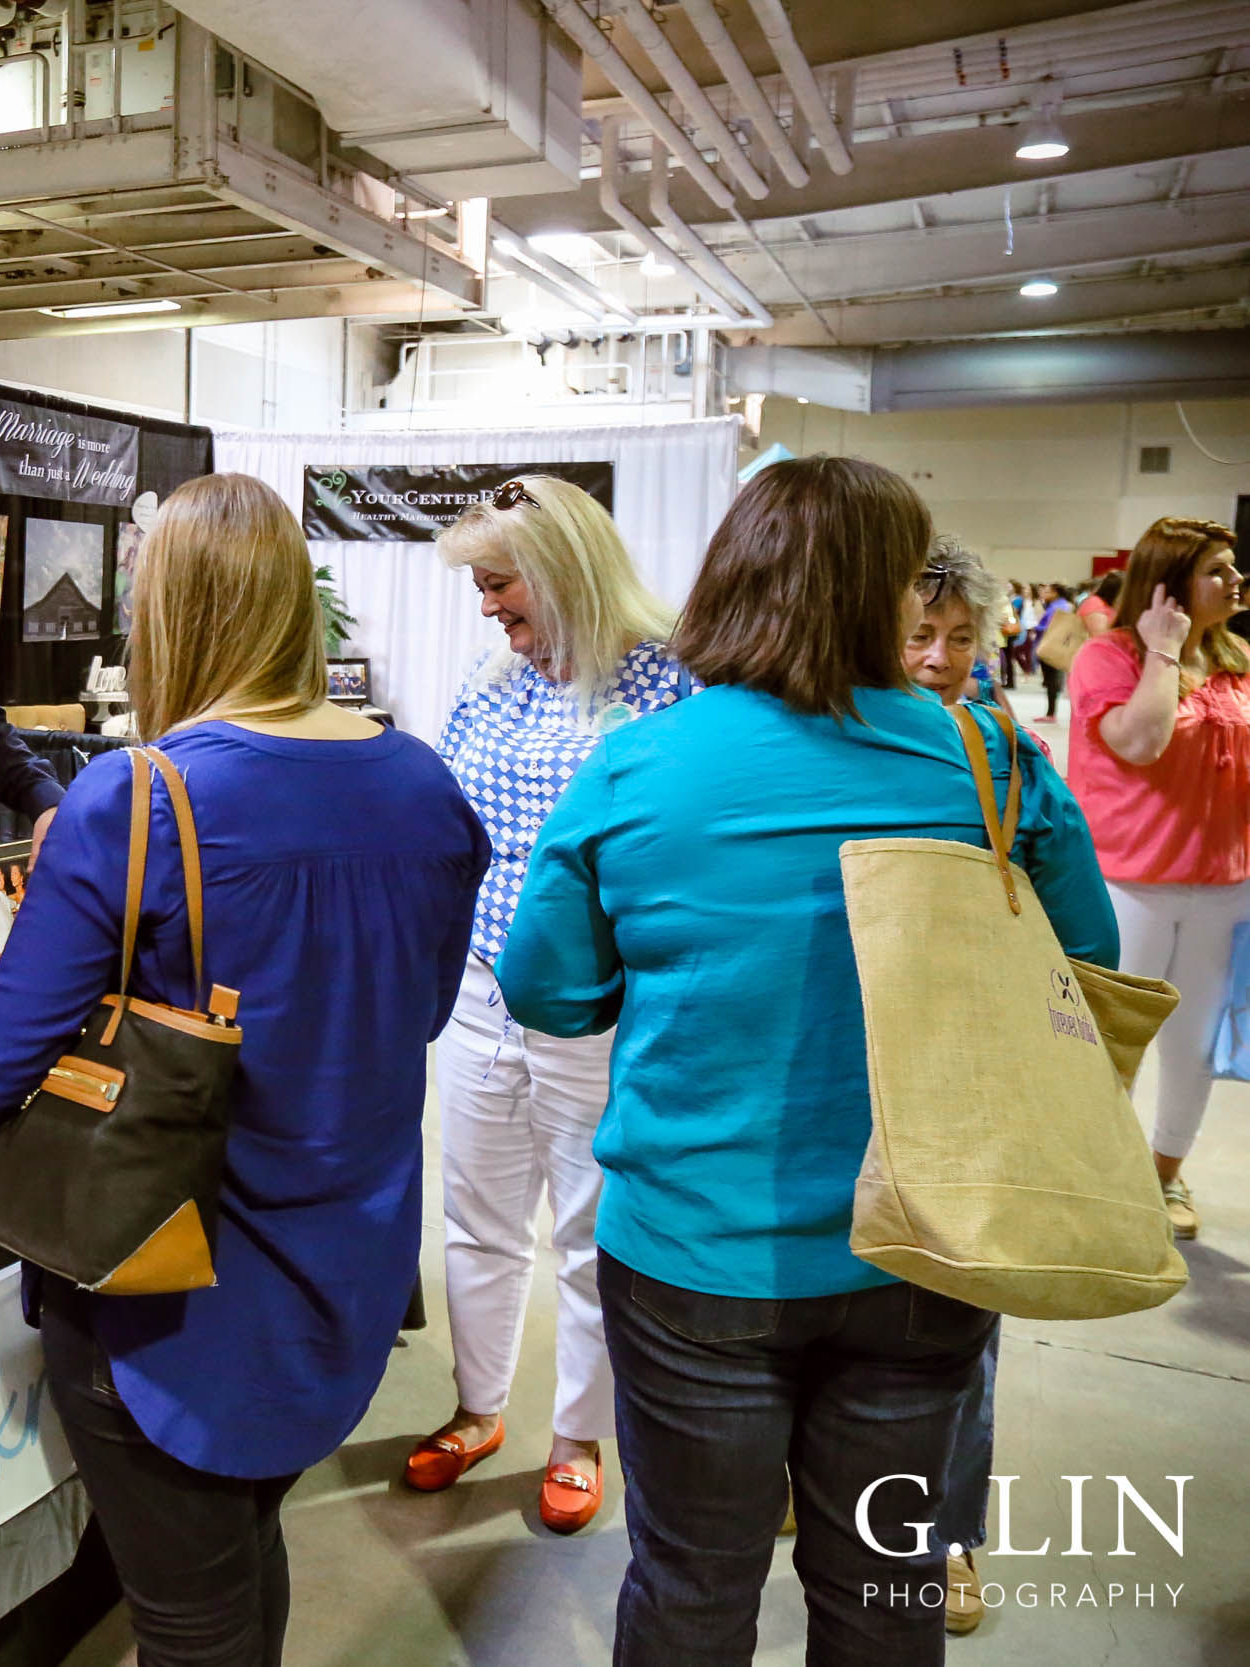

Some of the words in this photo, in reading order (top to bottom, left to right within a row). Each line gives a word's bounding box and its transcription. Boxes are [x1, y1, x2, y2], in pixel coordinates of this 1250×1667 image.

[77, 433, 87, 449] is
[87, 441, 111, 454] more
[19, 453, 45, 477] than
[46, 463, 64, 482] just
[65, 470, 70, 481] a
[72, 457, 135, 501] Wedding
